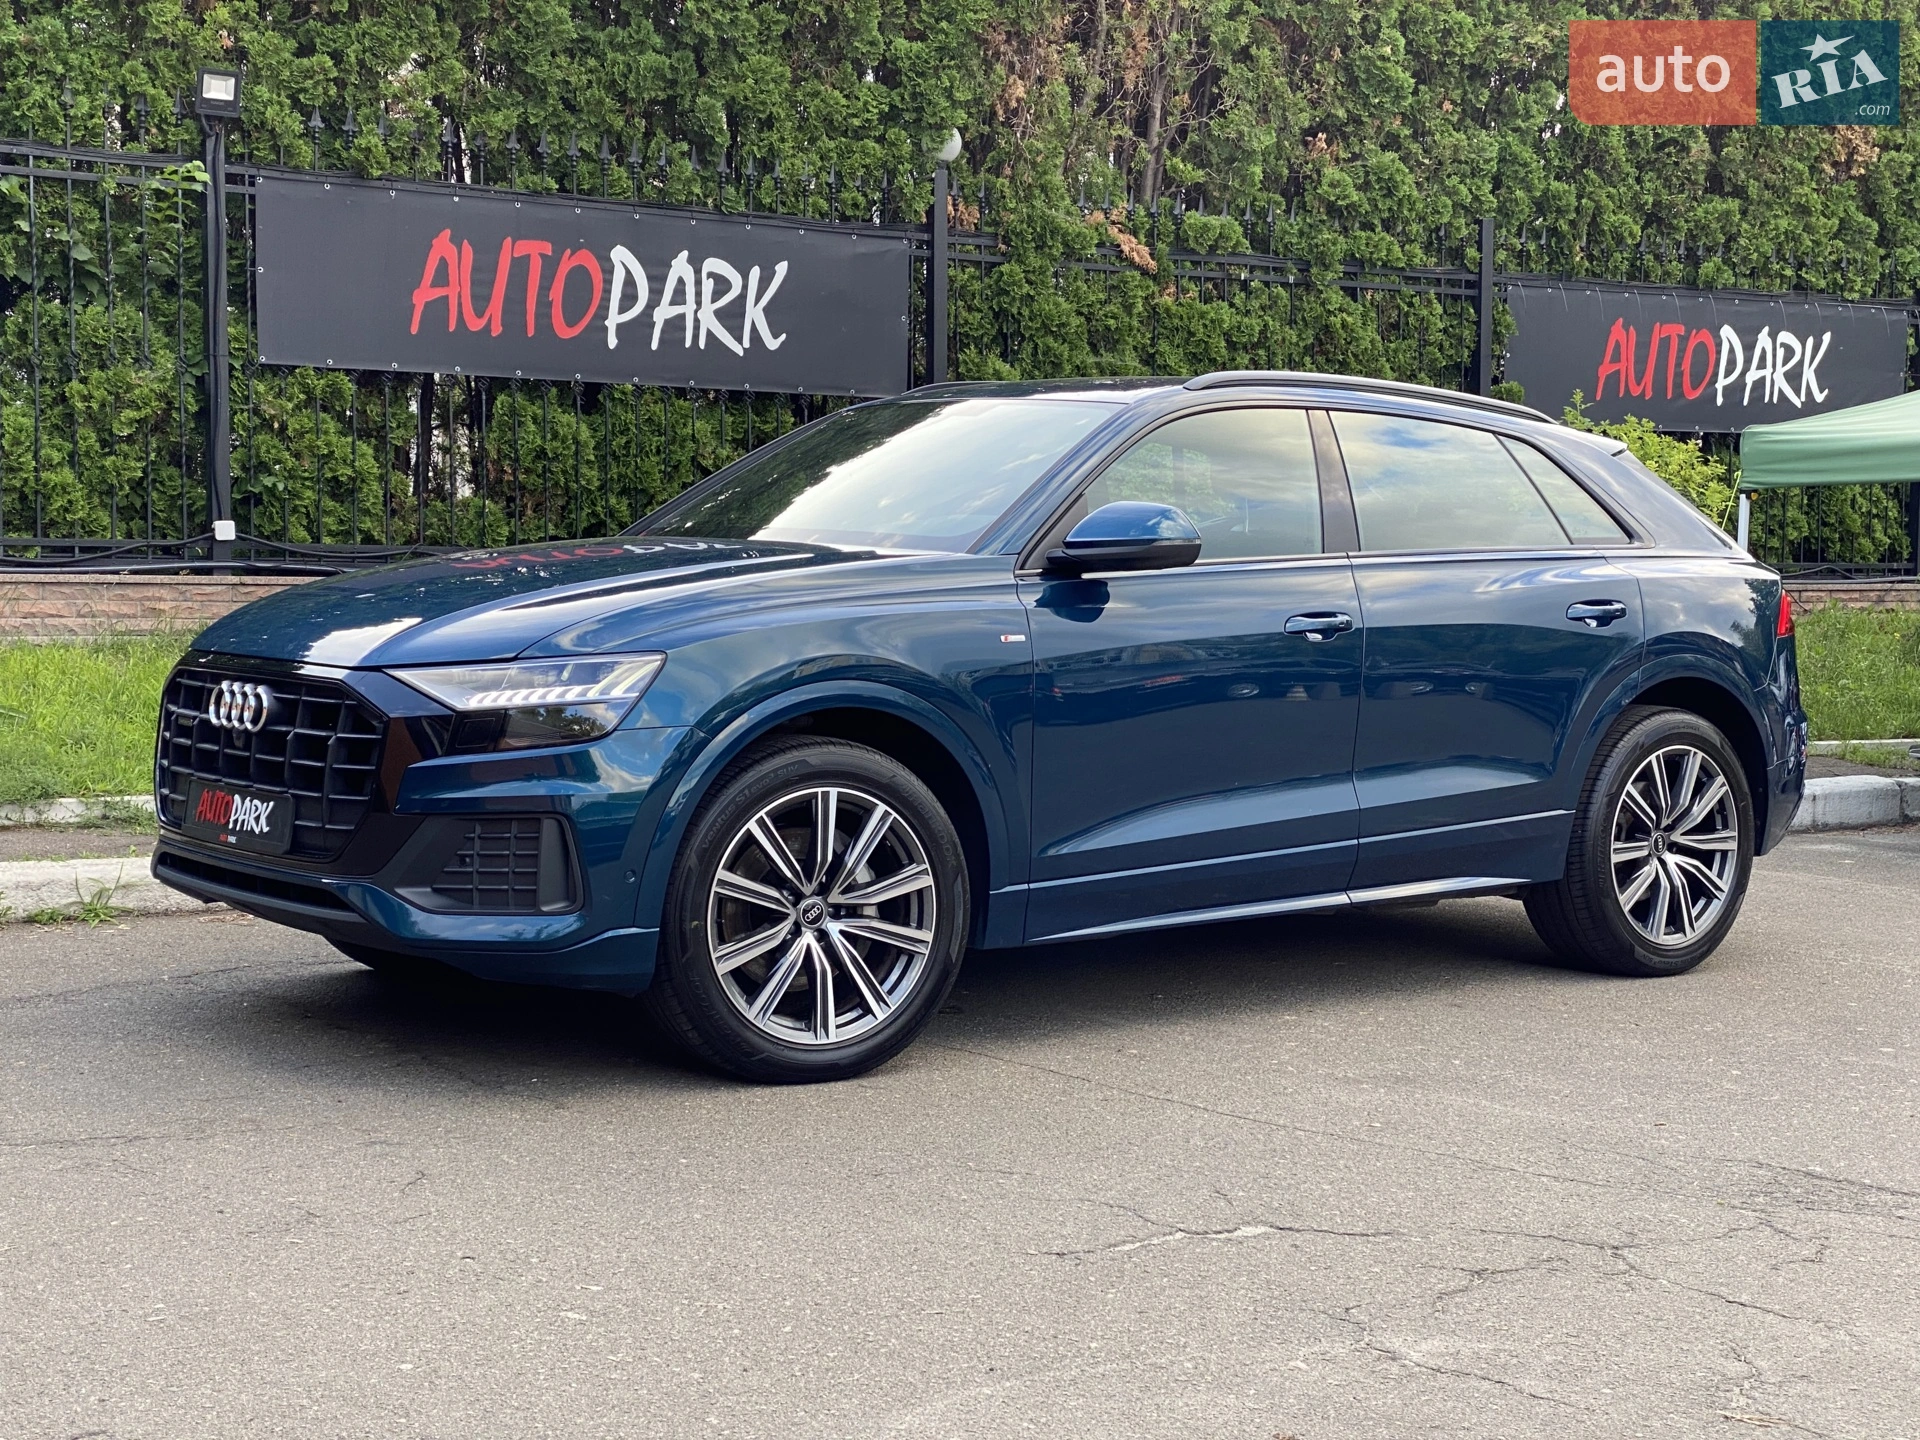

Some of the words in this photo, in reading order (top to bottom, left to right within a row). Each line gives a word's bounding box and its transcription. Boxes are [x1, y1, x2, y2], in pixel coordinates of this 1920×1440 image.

[410, 228, 789, 356] AUTOPARK
[1596, 317, 1832, 409] AUTOPARK
[195, 788, 274, 834] AUTOPARK
